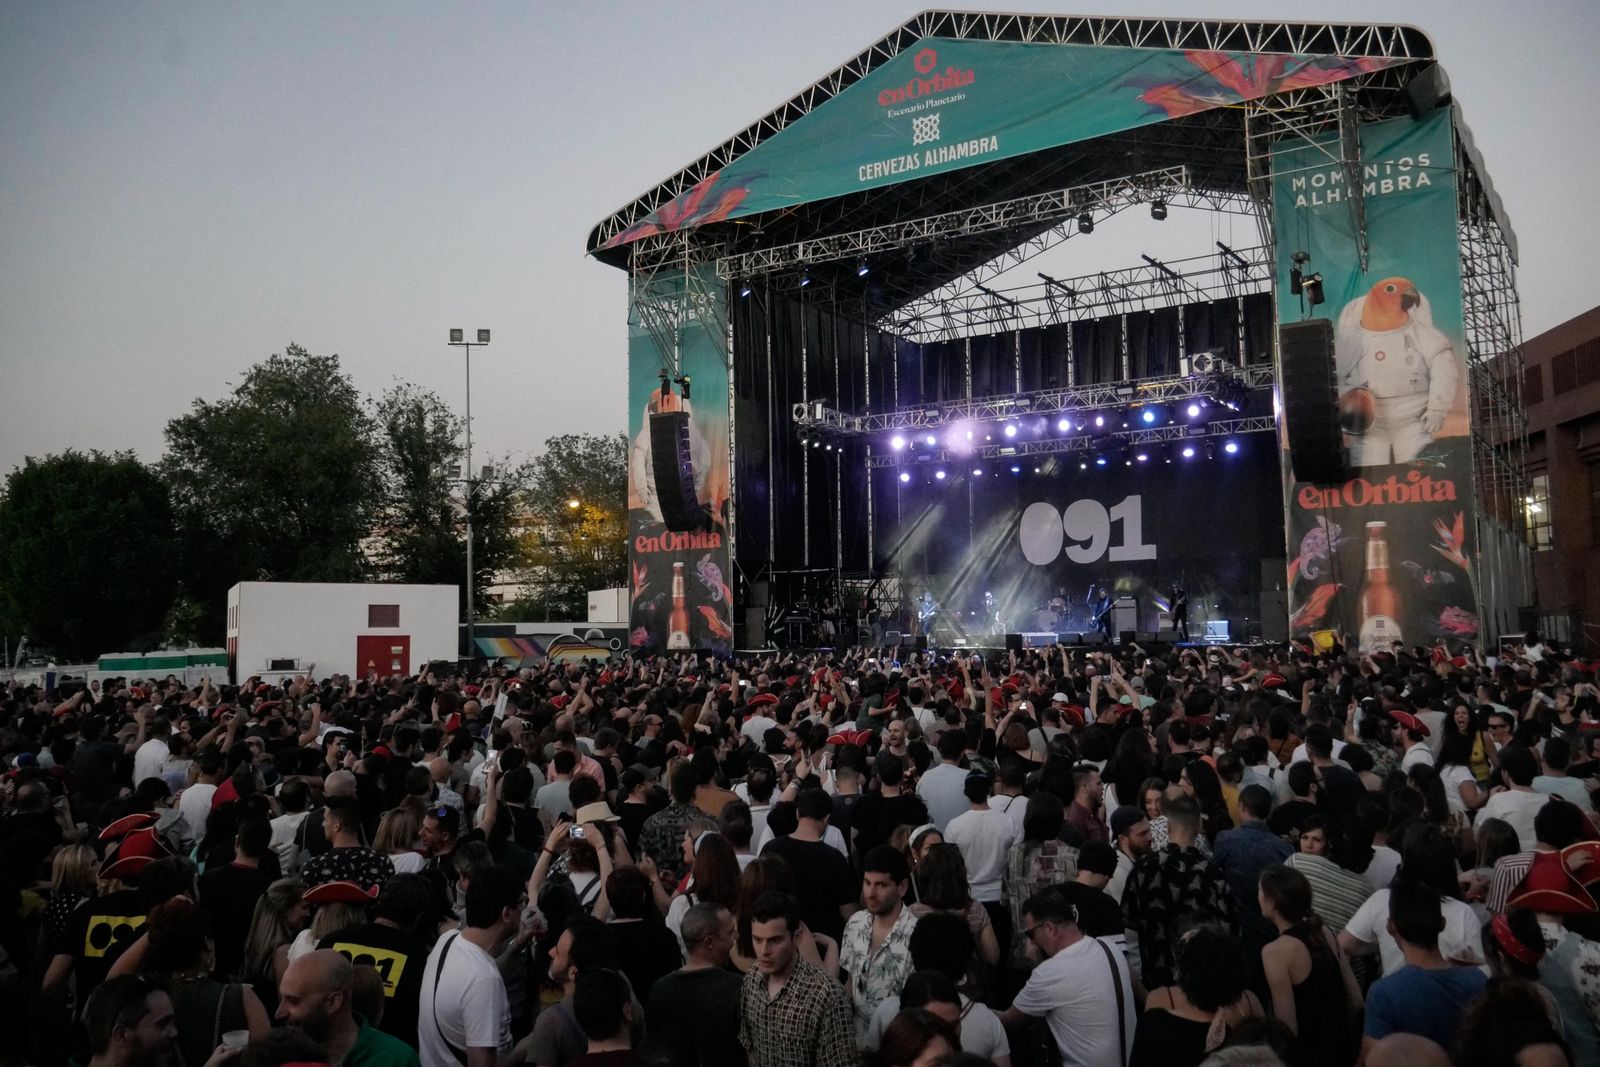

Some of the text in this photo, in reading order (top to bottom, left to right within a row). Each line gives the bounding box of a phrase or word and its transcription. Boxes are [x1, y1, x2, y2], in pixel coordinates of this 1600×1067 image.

[887, 93, 966, 118] Escenario Planetario
[859, 135, 998, 182] CERVEZAS ALHAMBRA
[1292, 153, 1430, 192] MOMNTOS
[1294, 172, 1432, 209] ALHMBRA
[1020, 495, 1157, 566] 091
